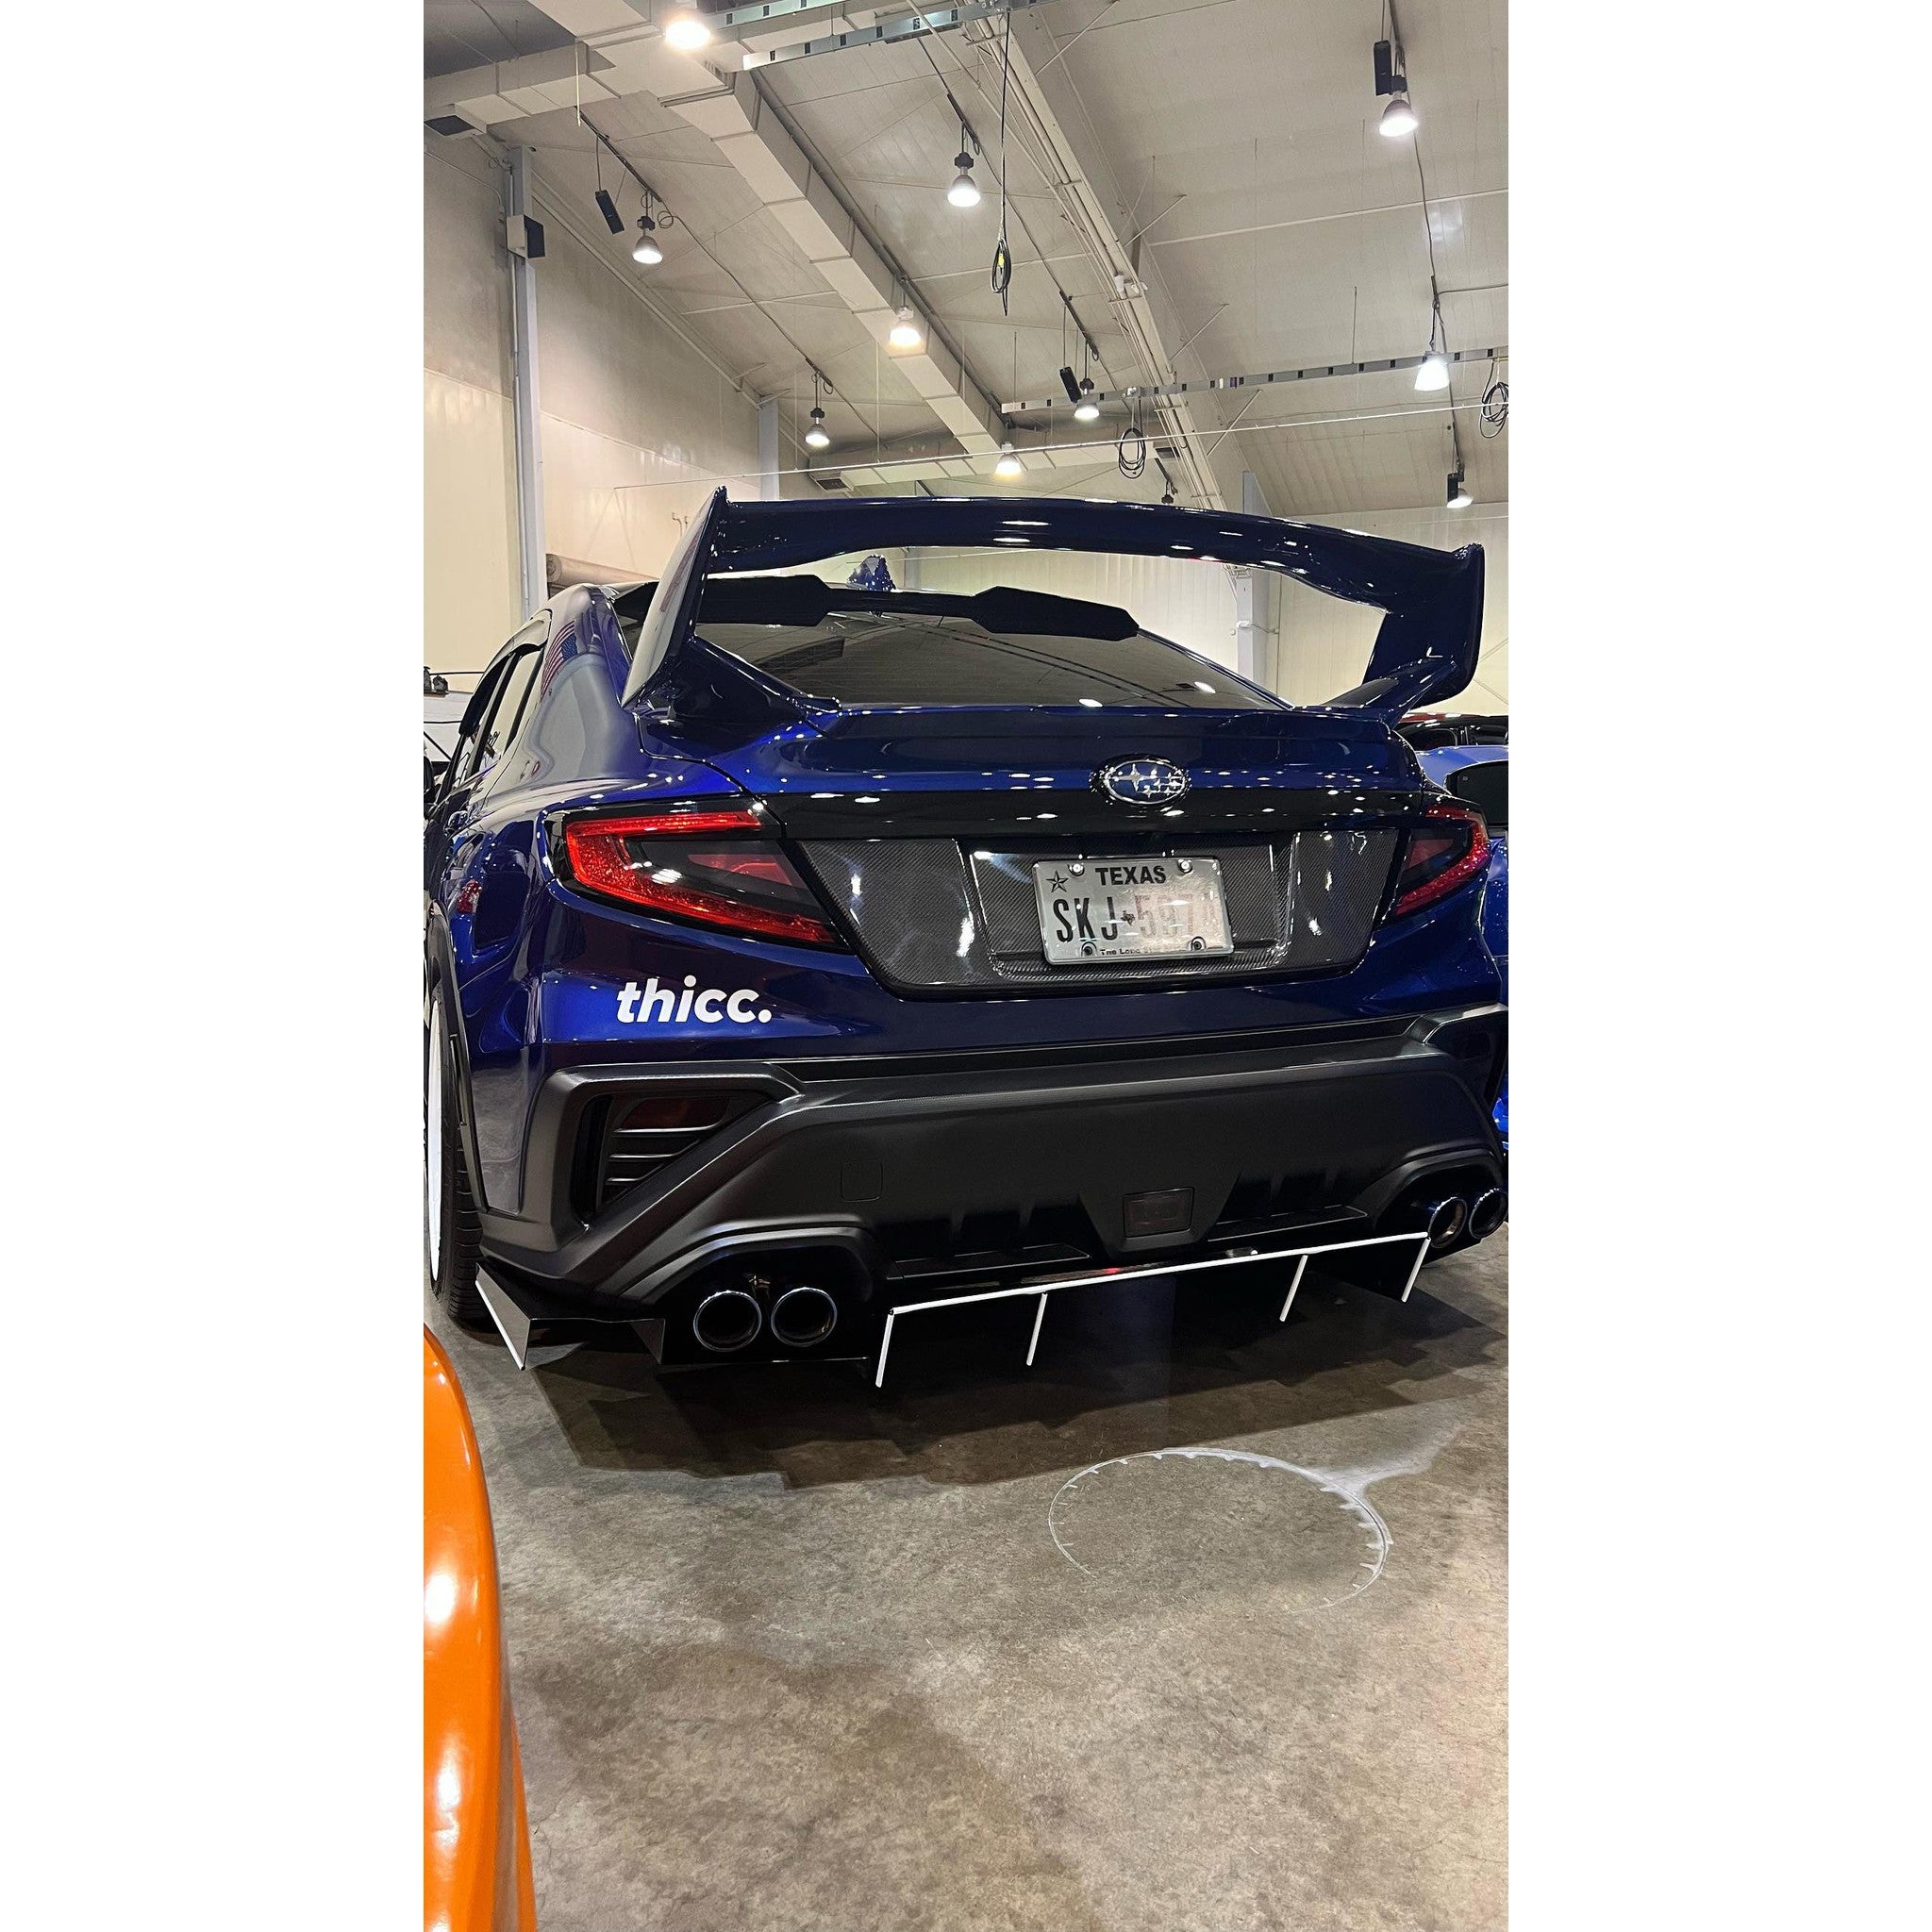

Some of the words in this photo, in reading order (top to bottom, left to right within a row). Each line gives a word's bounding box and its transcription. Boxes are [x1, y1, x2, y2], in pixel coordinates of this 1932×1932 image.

[1095, 865, 1166, 886] TEXAS
[1053, 896, 1119, 942] SKJ
[1134, 893, 1220, 941] 597
[617, 974, 772, 1024] thicc.
